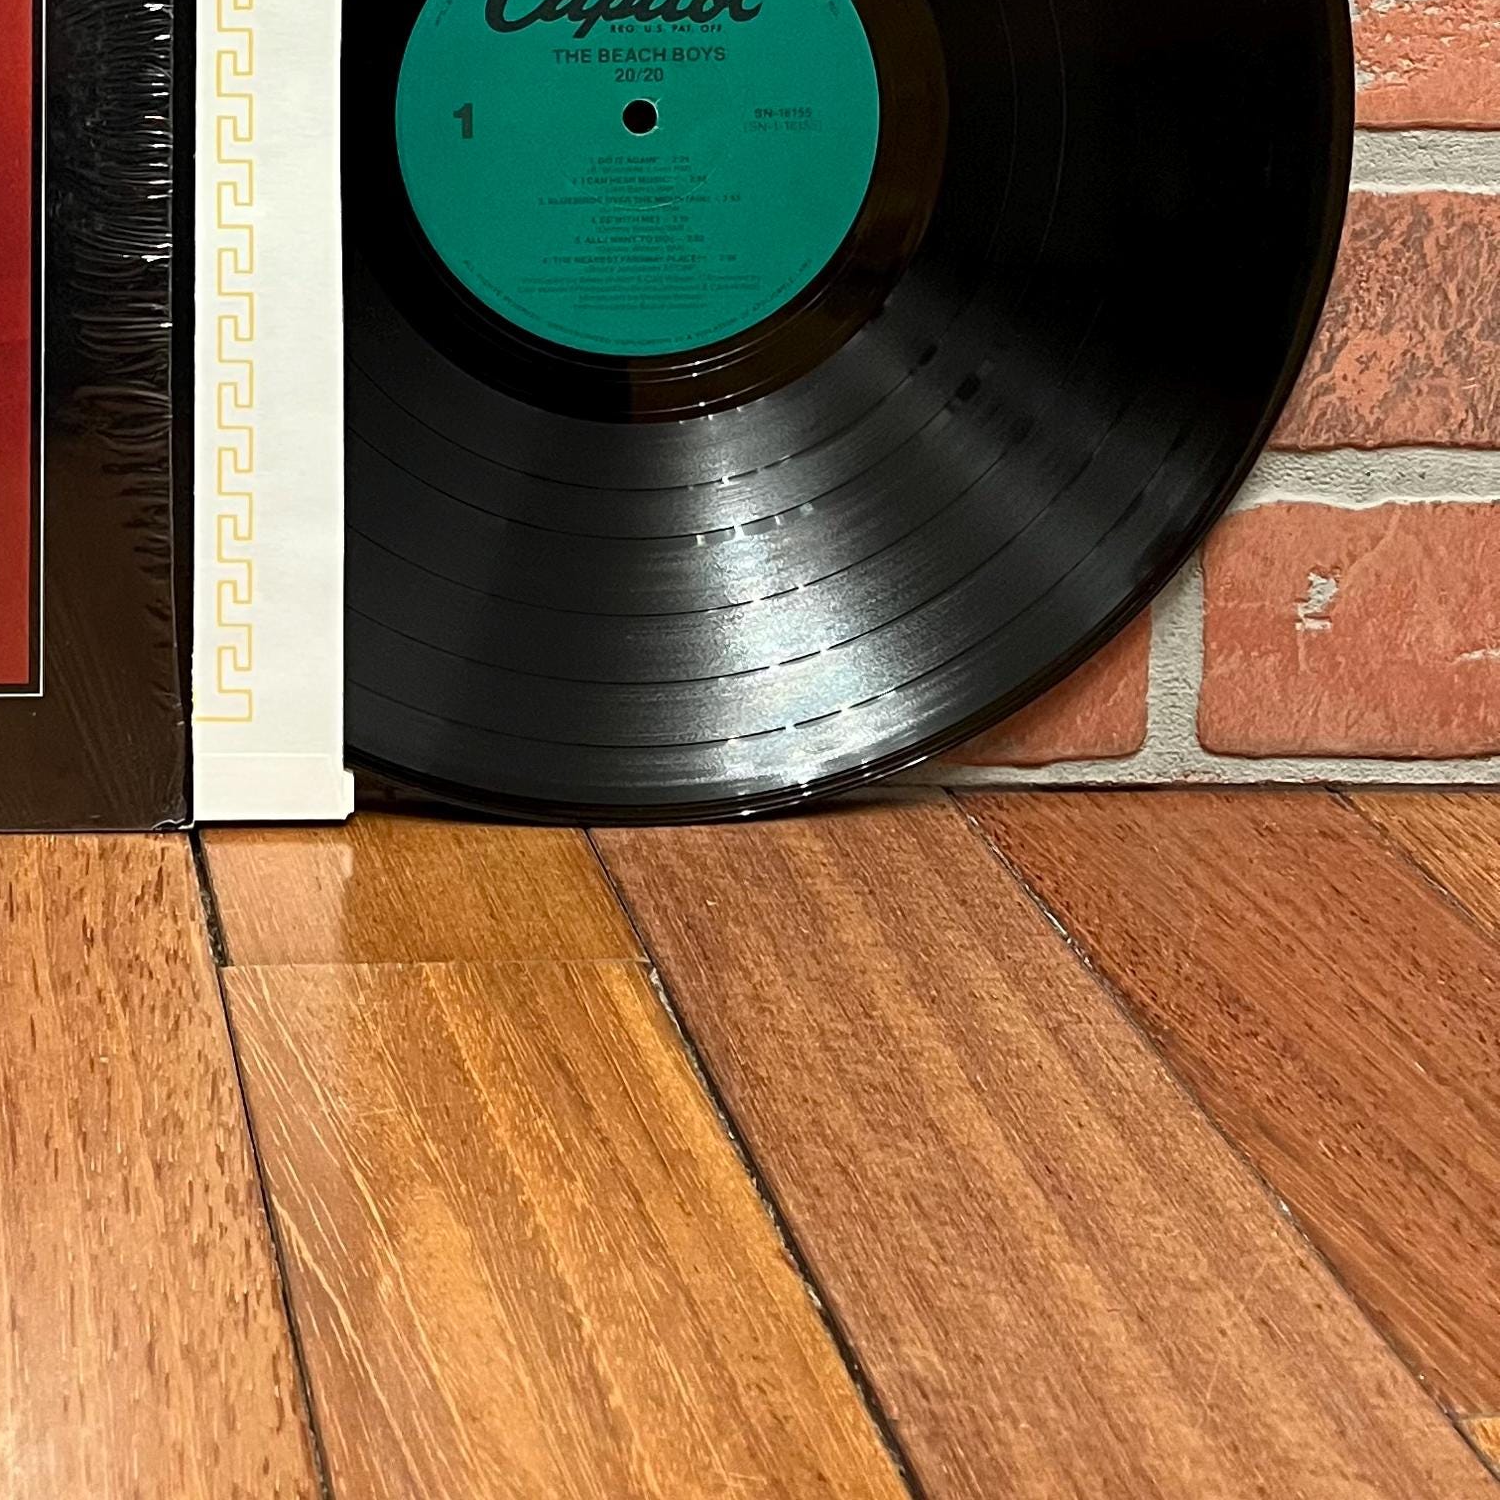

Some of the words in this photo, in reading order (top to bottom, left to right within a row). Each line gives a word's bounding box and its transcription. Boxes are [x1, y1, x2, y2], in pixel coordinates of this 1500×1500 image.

[553, 48, 592, 64] THE
[597, 47, 667, 64] BEACH
[672, 45, 726, 62] BOYS
[614, 67, 664, 83] 20/20
[452, 102, 474, 140] 1
